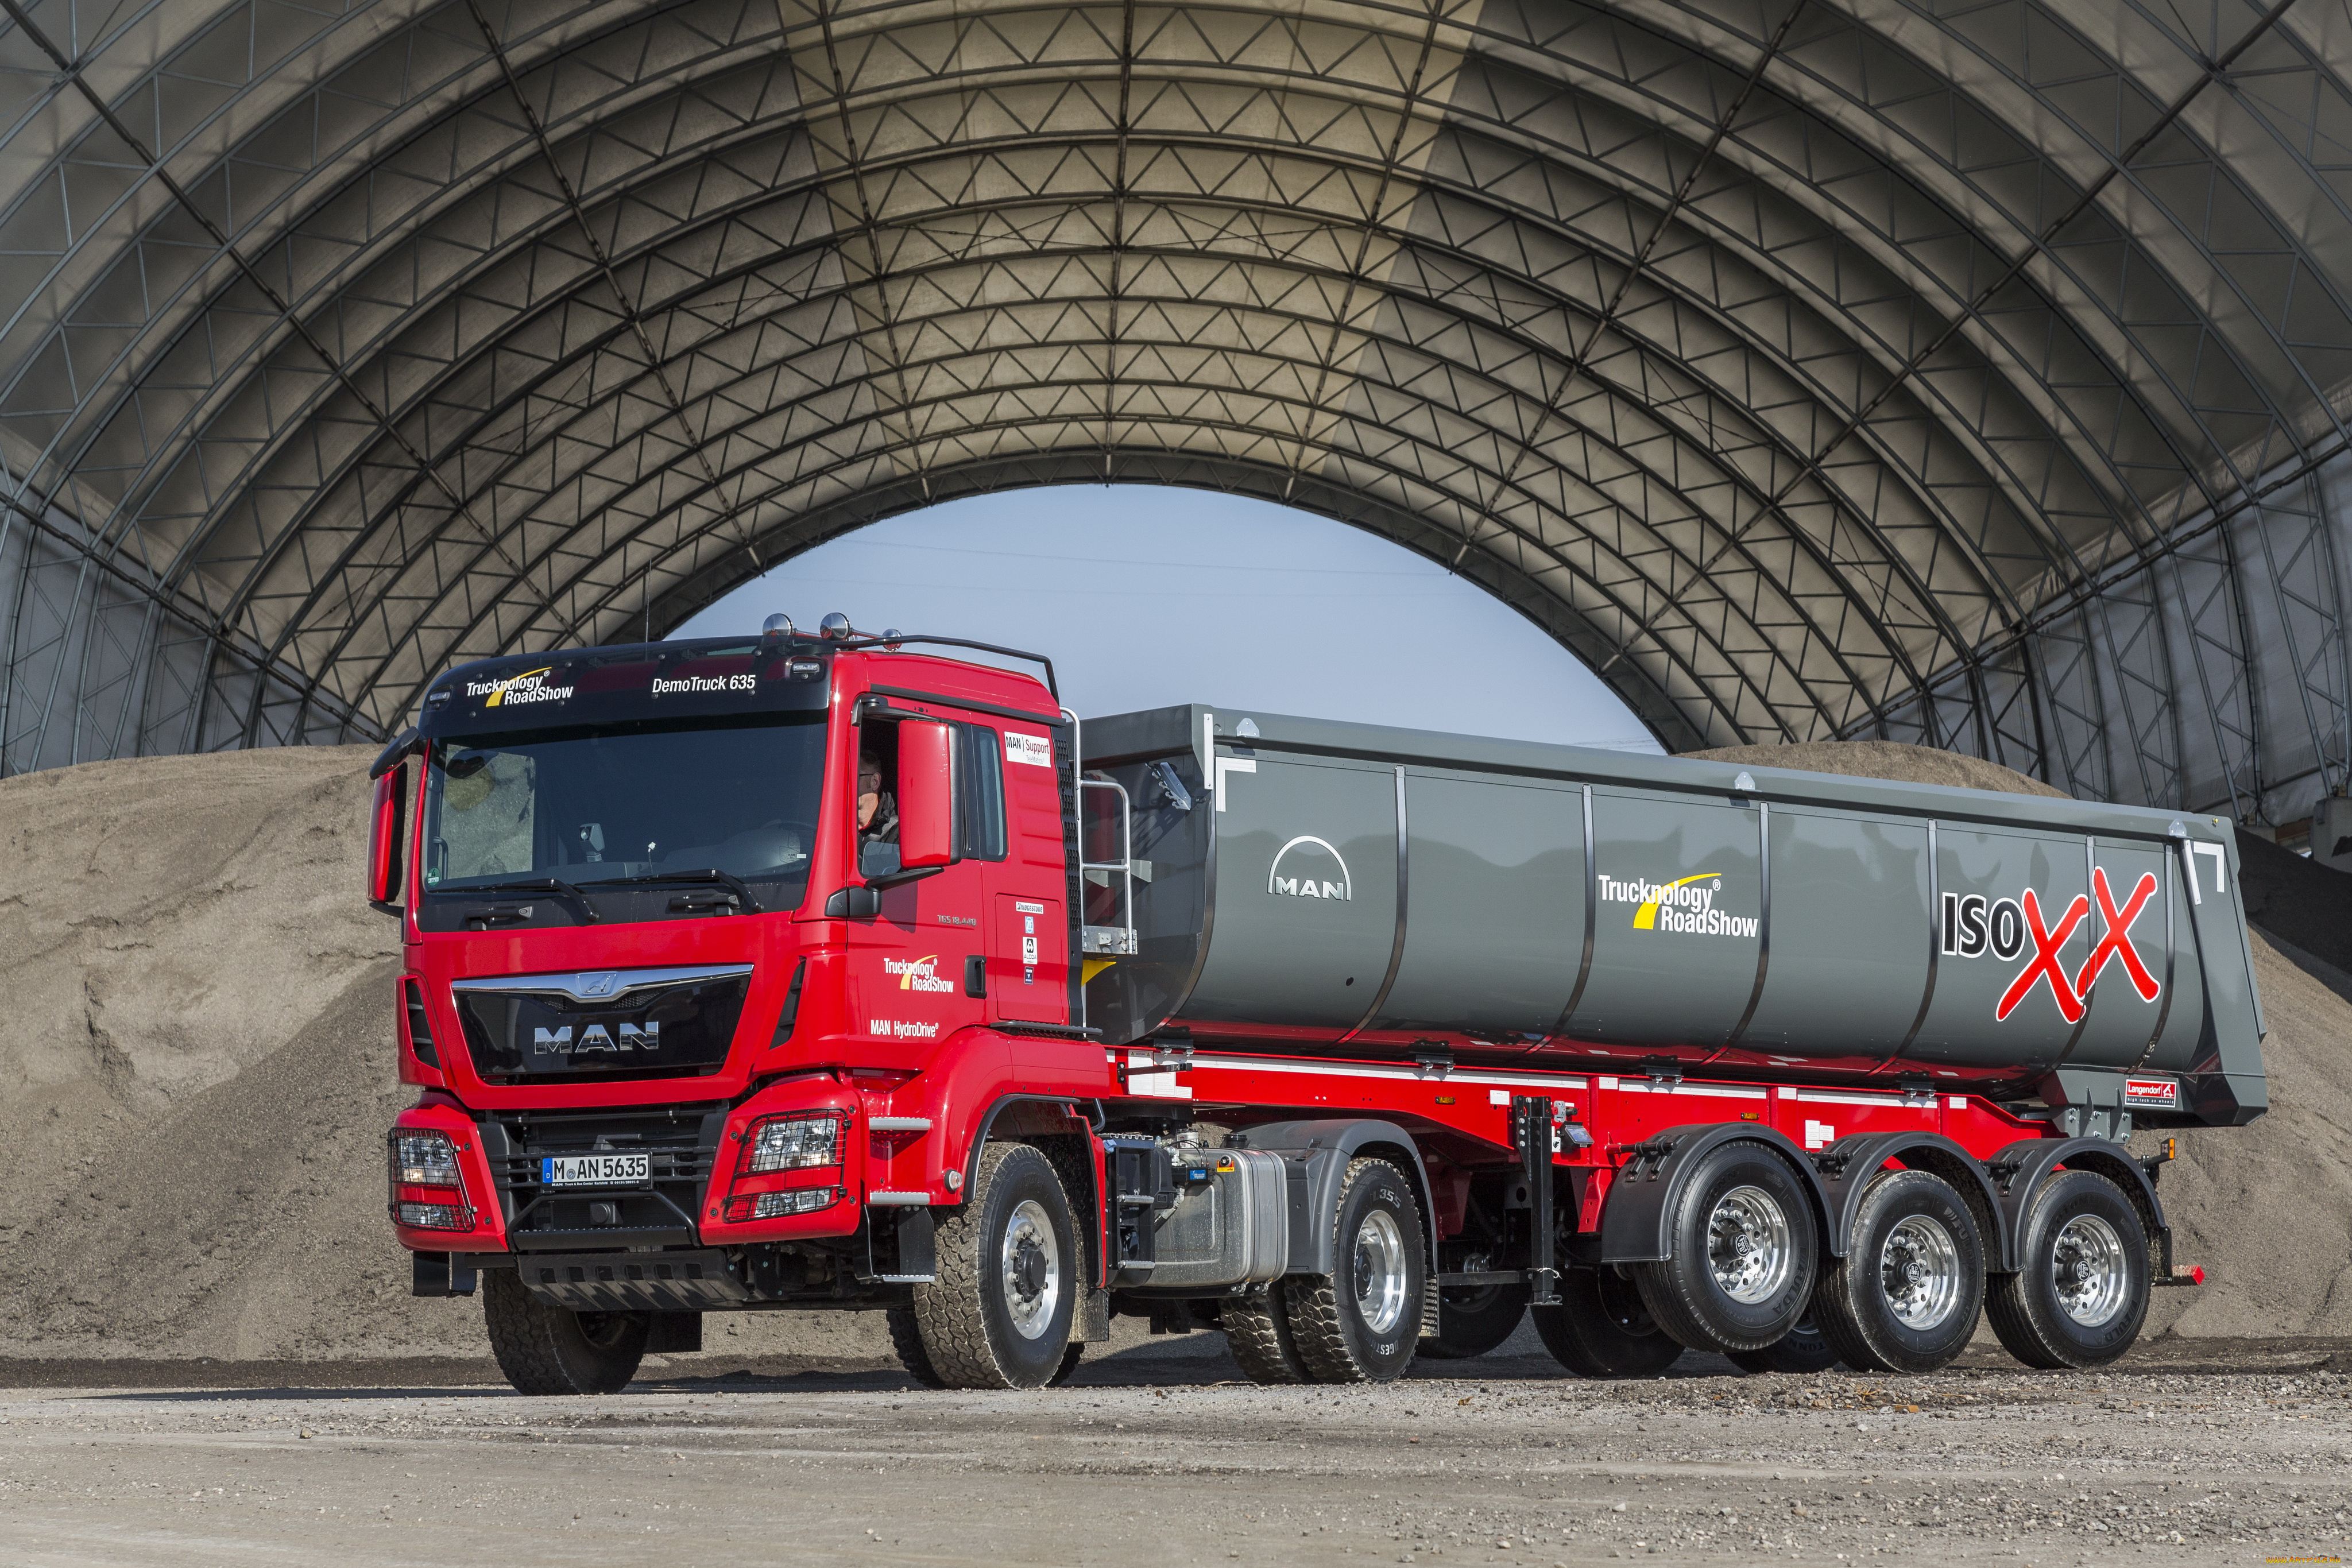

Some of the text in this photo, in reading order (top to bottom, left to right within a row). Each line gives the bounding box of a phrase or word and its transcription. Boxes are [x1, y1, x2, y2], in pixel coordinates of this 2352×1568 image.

[652, 675, 756, 693] DemoTruck 635
[504, 686, 574, 705] RoadShow
[1006, 736, 1049, 755] MAN Support
[432, 868, 436, 877] 4
[1275, 877, 1344, 900] MAN
[1017, 903, 1043, 912] BRIDGESTONE
[937, 915, 976, 927] TGS 18.440
[1661, 905, 1758, 938] RoadShow
[912, 975, 954, 993] RoadShow
[871, 1020, 890, 1035] MAN
[535, 1021, 659, 1055] MAN
[2128, 1084, 2161, 1095] Langendorf
[554, 1157, 647, 1179] M AN 5635
[1373, 1188, 1401, 1209] L355
